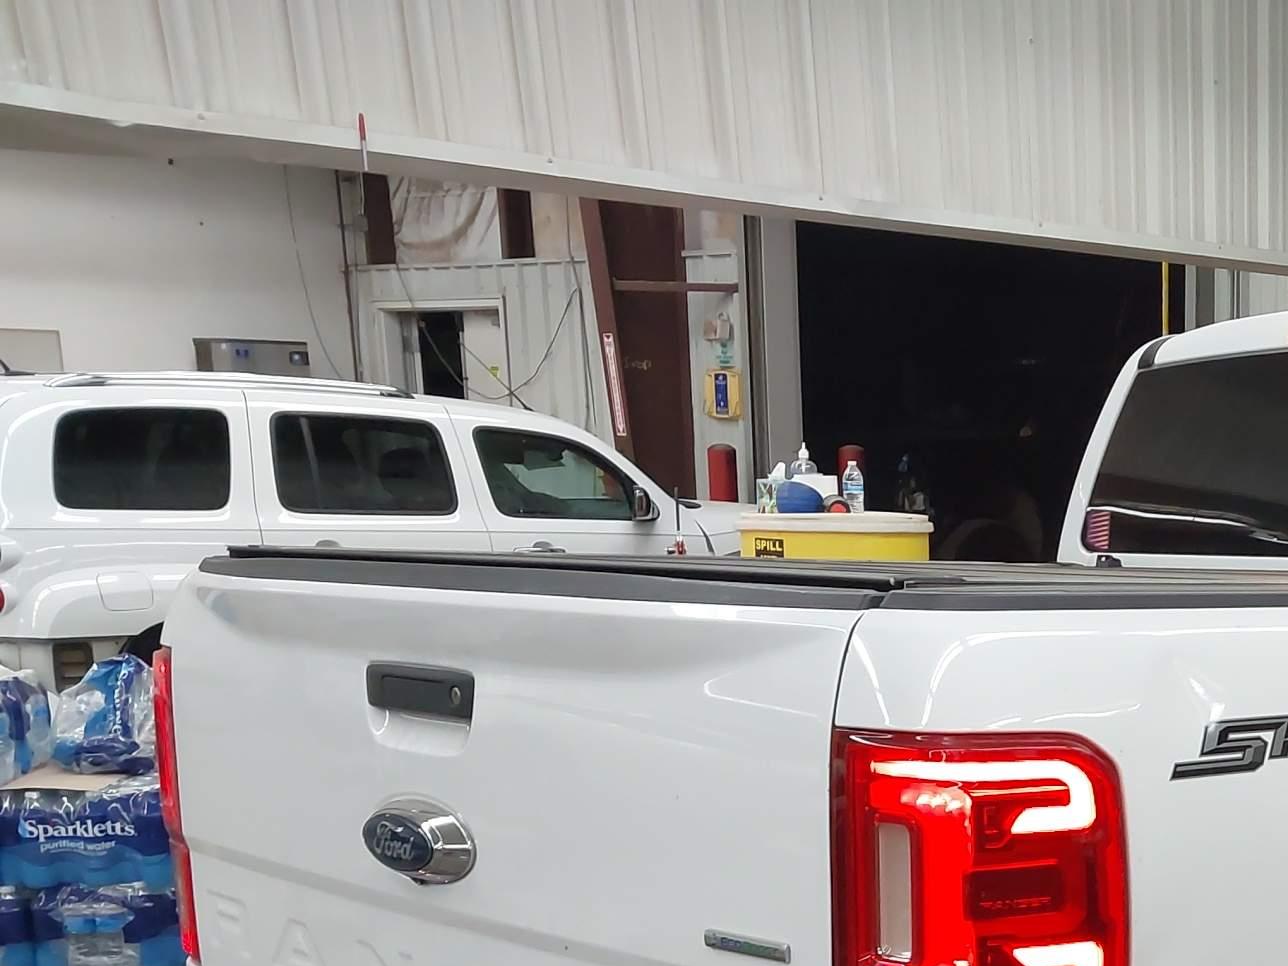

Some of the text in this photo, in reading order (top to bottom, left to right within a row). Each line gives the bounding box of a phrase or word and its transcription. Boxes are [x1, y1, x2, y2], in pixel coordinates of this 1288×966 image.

[755, 539, 783, 551] SPILL
[24, 819, 136, 842] Sparkletts
[40, 840, 84, 854] purified
[372, 820, 416, 861] Ford
